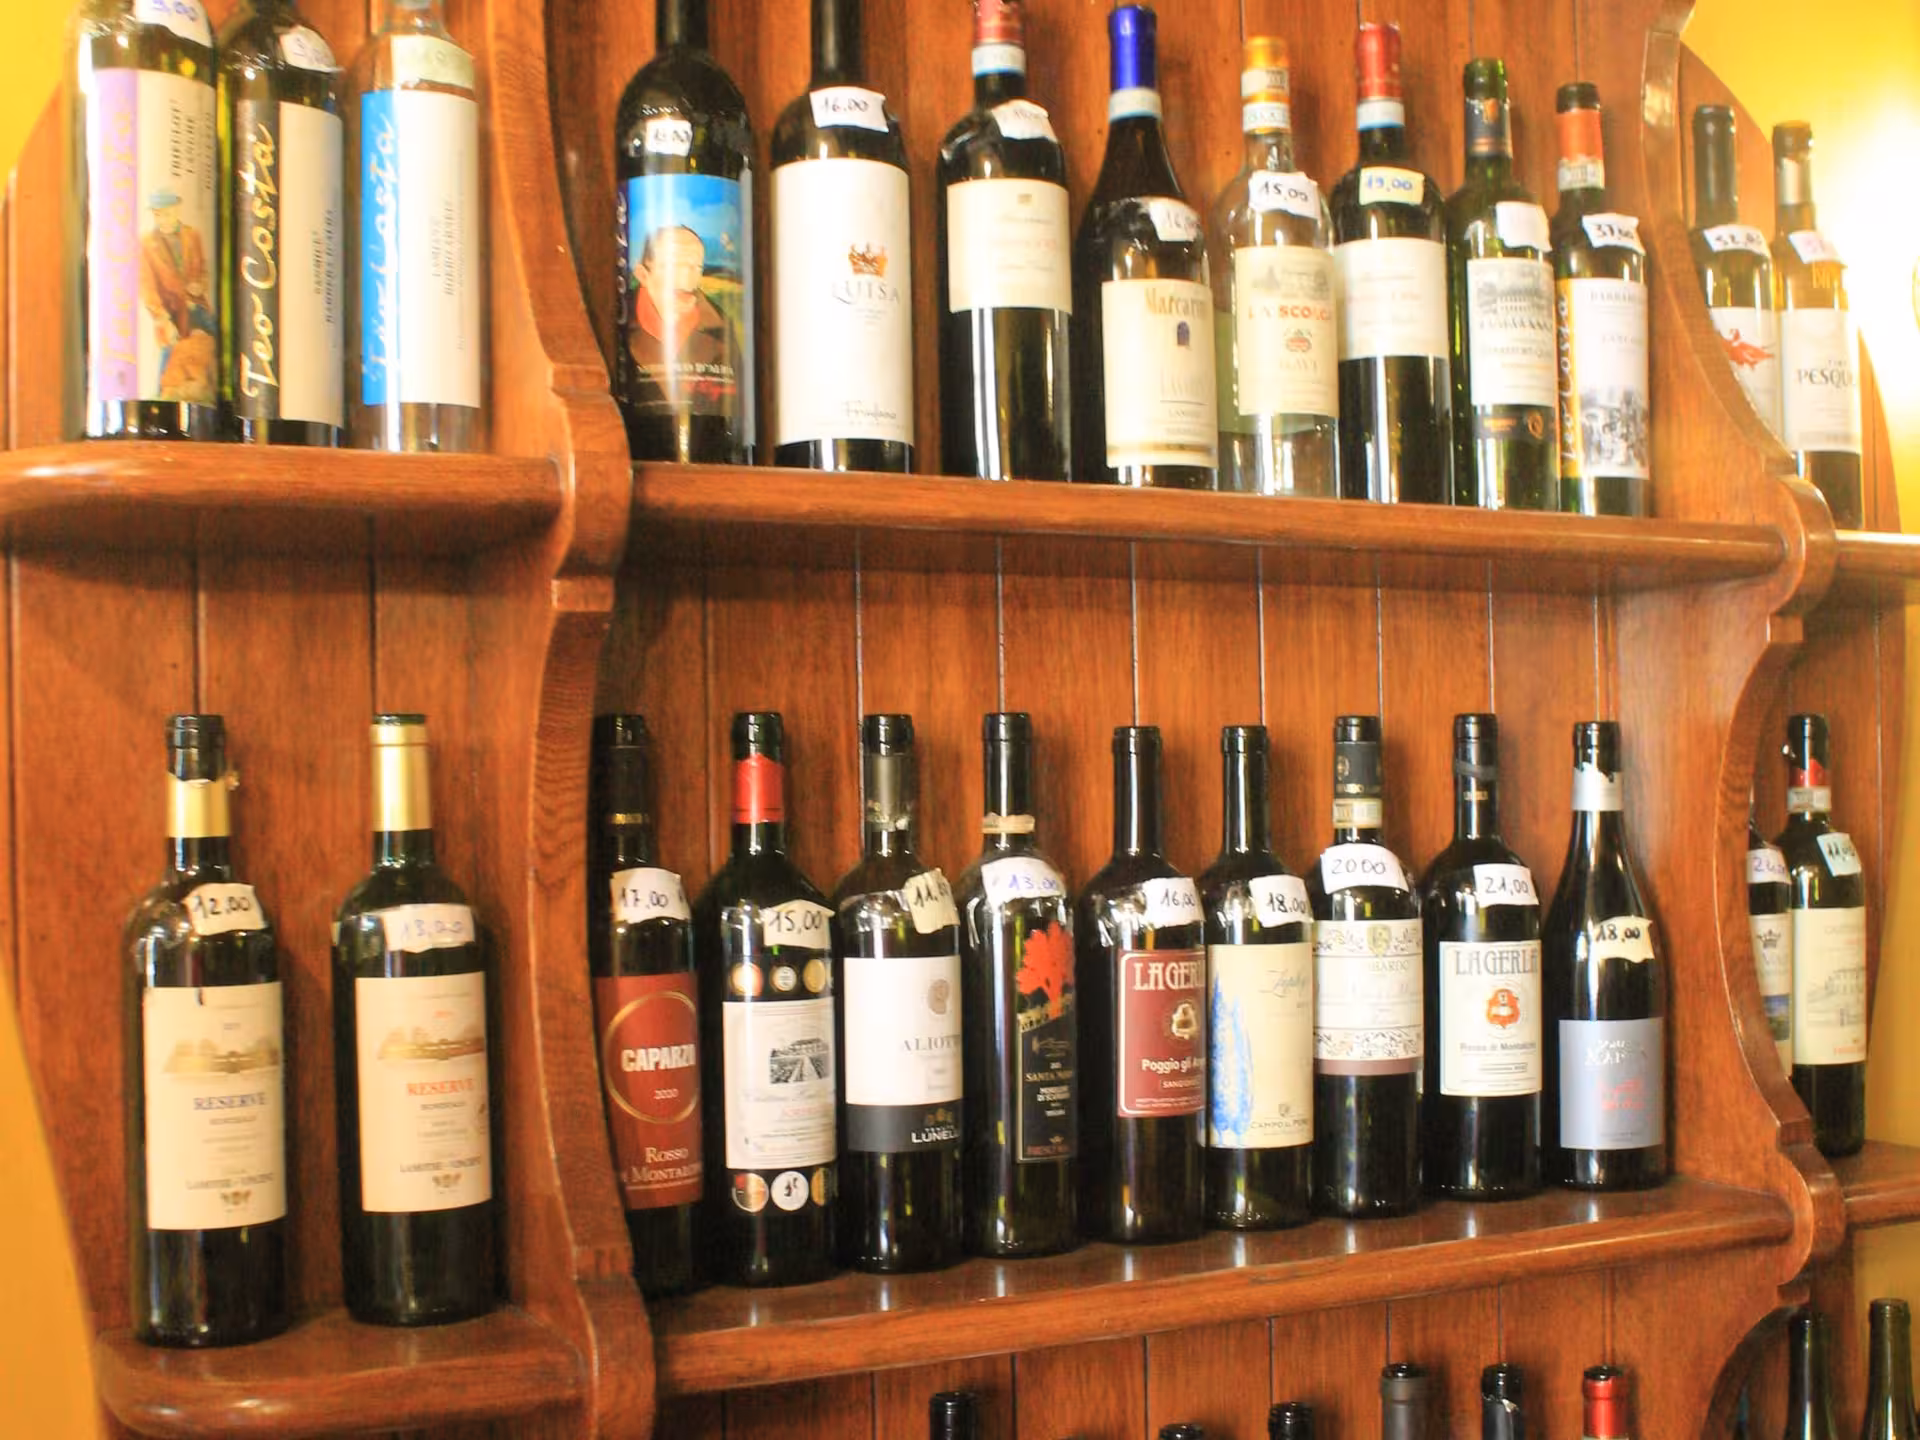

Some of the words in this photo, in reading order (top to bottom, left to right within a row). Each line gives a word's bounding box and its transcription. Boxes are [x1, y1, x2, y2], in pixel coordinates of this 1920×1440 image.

[238, 123, 278, 289] Costa
[239, 292, 279, 398] Teo
[1141, 1056, 1180, 1075] Poggio
[406, 1078, 475, 1097] RESERVE
[193, 1091, 267, 1111] RESERVE
